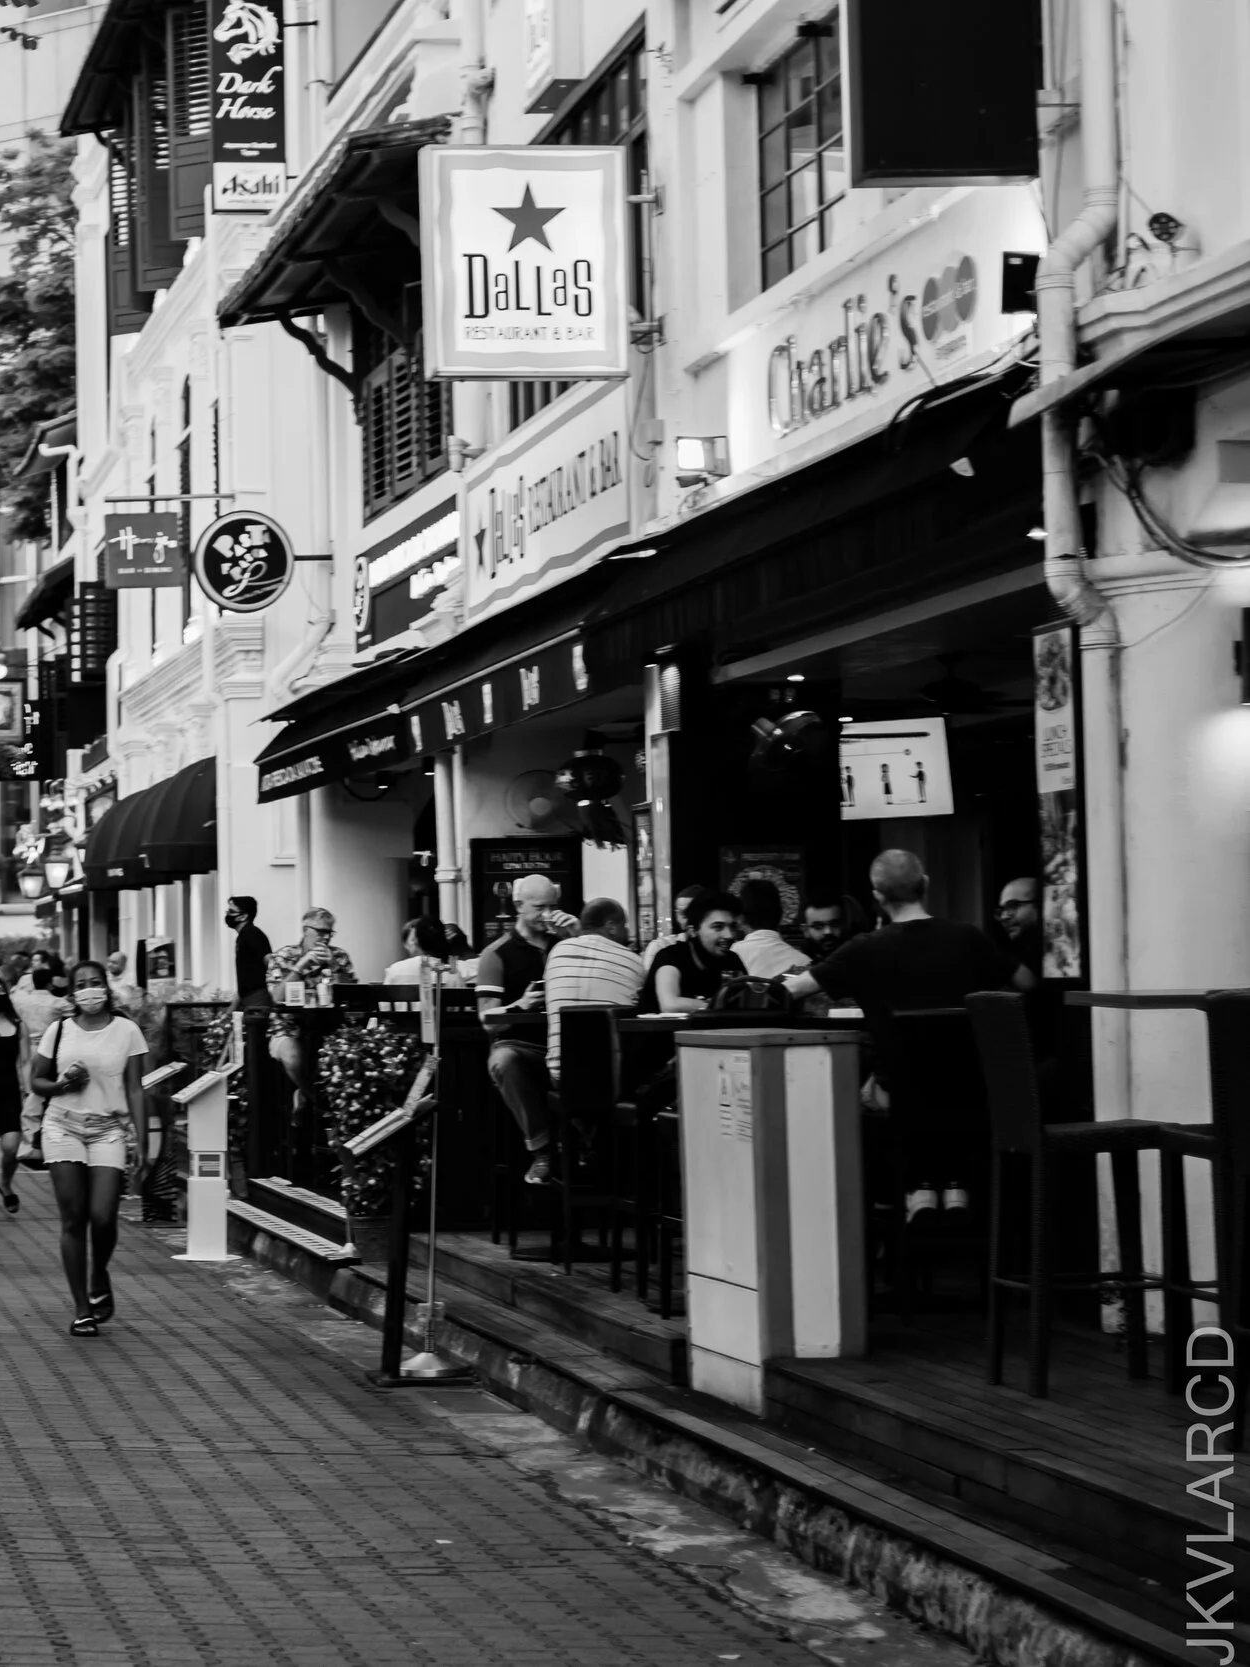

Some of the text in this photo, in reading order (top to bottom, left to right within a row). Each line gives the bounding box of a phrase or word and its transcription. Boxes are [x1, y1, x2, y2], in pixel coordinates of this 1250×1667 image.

[216, 66, 283, 94] Dark
[215, 96, 276, 119] Horse
[221, 174, 280, 196] Asahi
[768, 273, 918, 440] Charlie's
